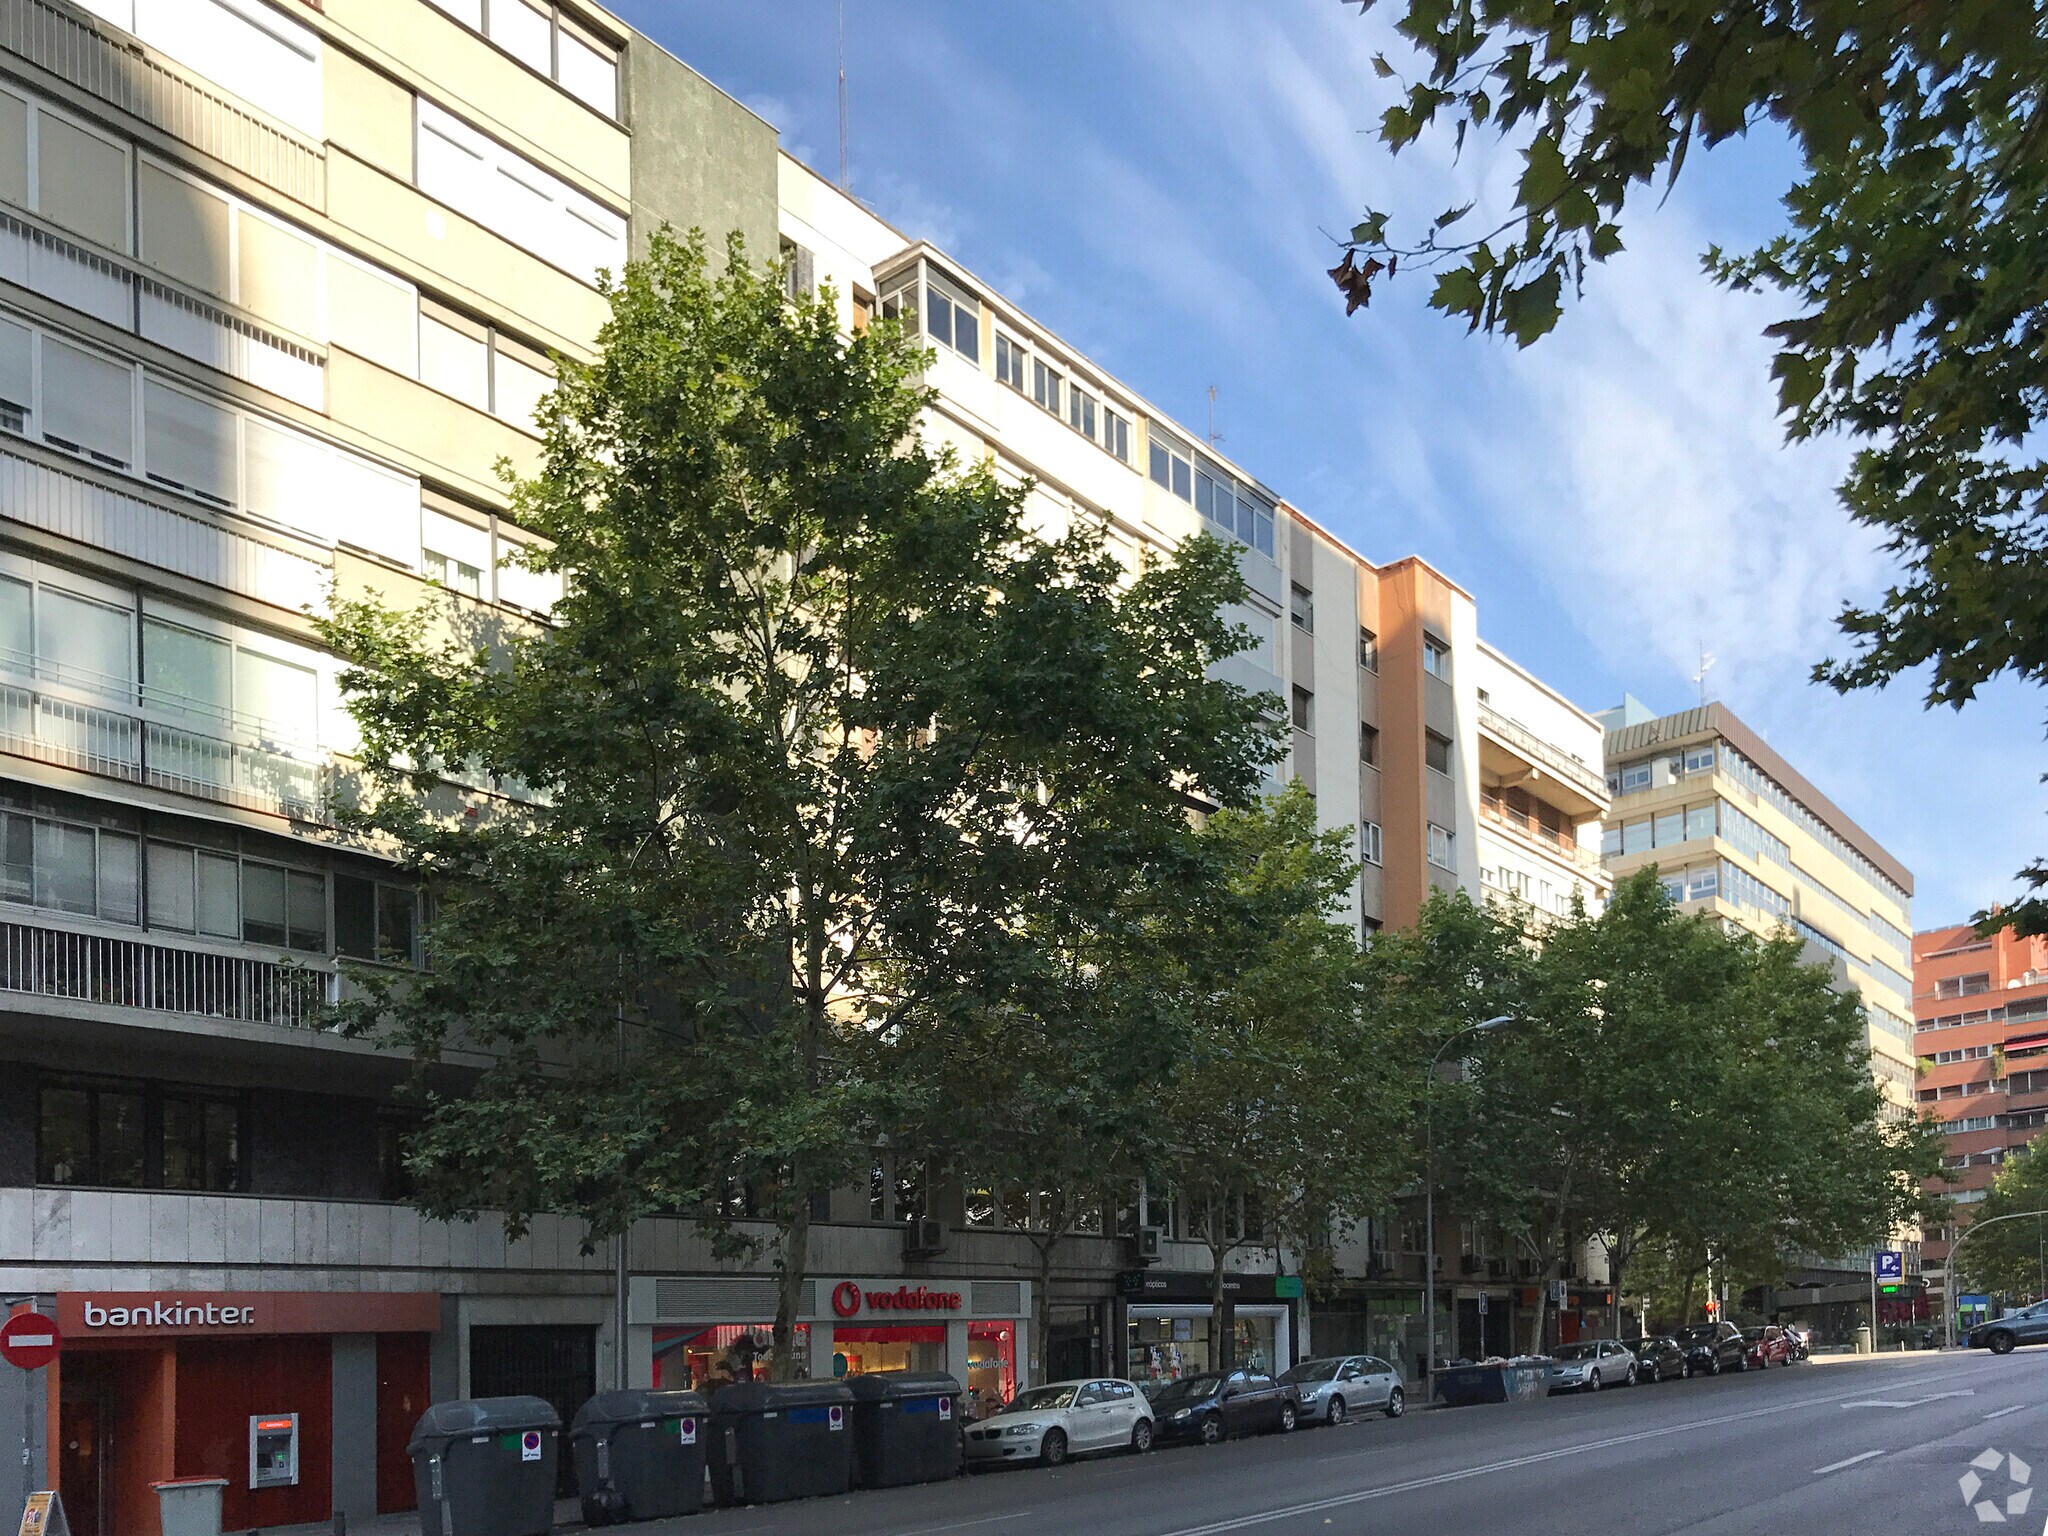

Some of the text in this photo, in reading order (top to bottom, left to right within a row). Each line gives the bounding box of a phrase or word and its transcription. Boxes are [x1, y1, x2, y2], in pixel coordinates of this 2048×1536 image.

[1882, 1255, 1893, 1270] P
[865, 1286, 962, 1310] vodafone
[84, 1301, 255, 1327] bankinter.
